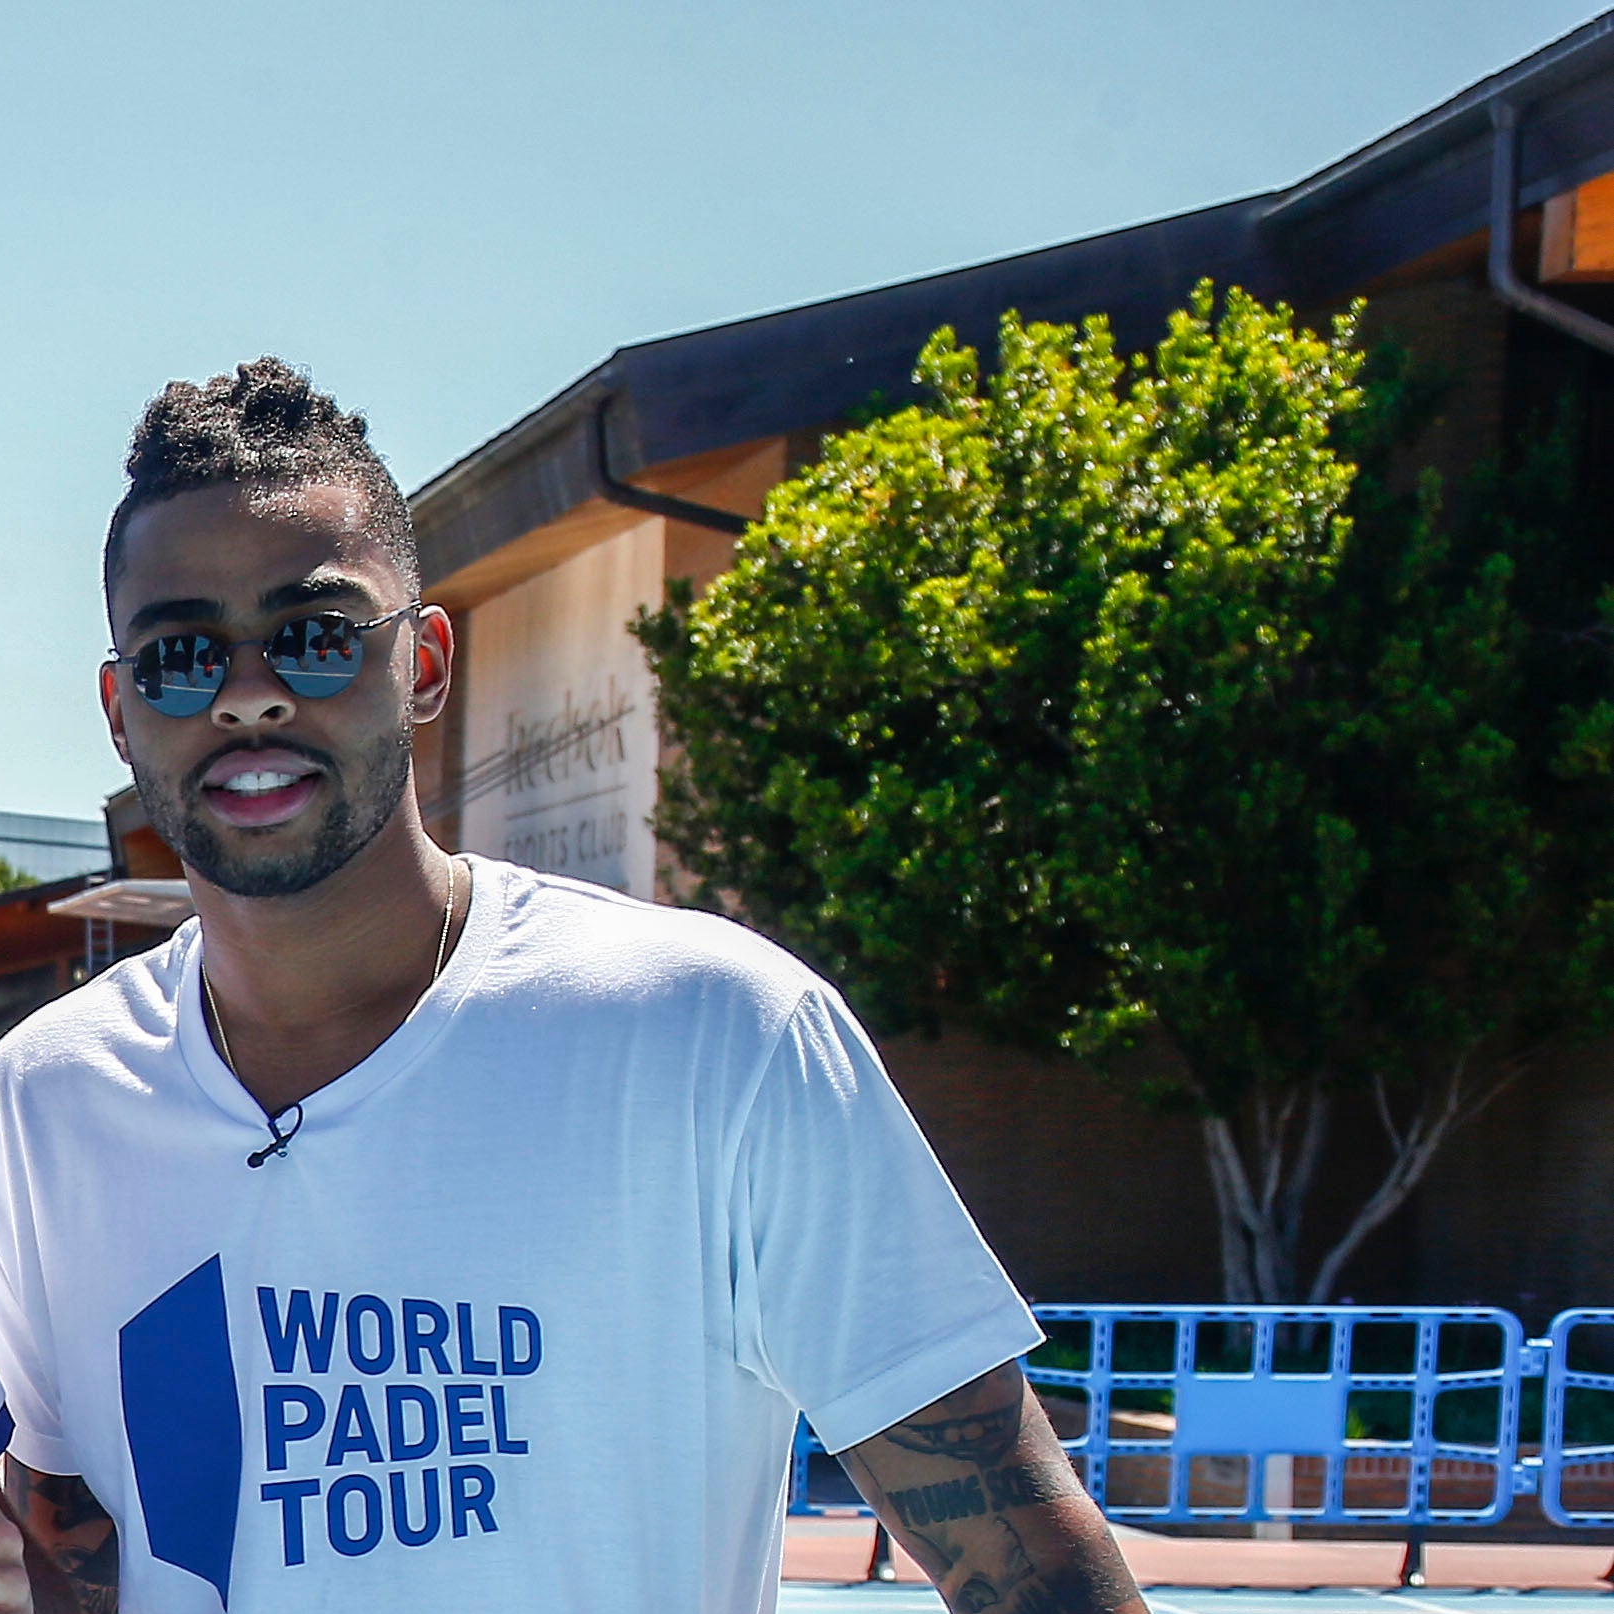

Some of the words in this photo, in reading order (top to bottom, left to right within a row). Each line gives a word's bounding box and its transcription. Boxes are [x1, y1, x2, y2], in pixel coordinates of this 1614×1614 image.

[257, 1286, 543, 1377] WORLD
[262, 1384, 530, 1472] PADEL
[260, 1465, 498, 1567] TOUR
